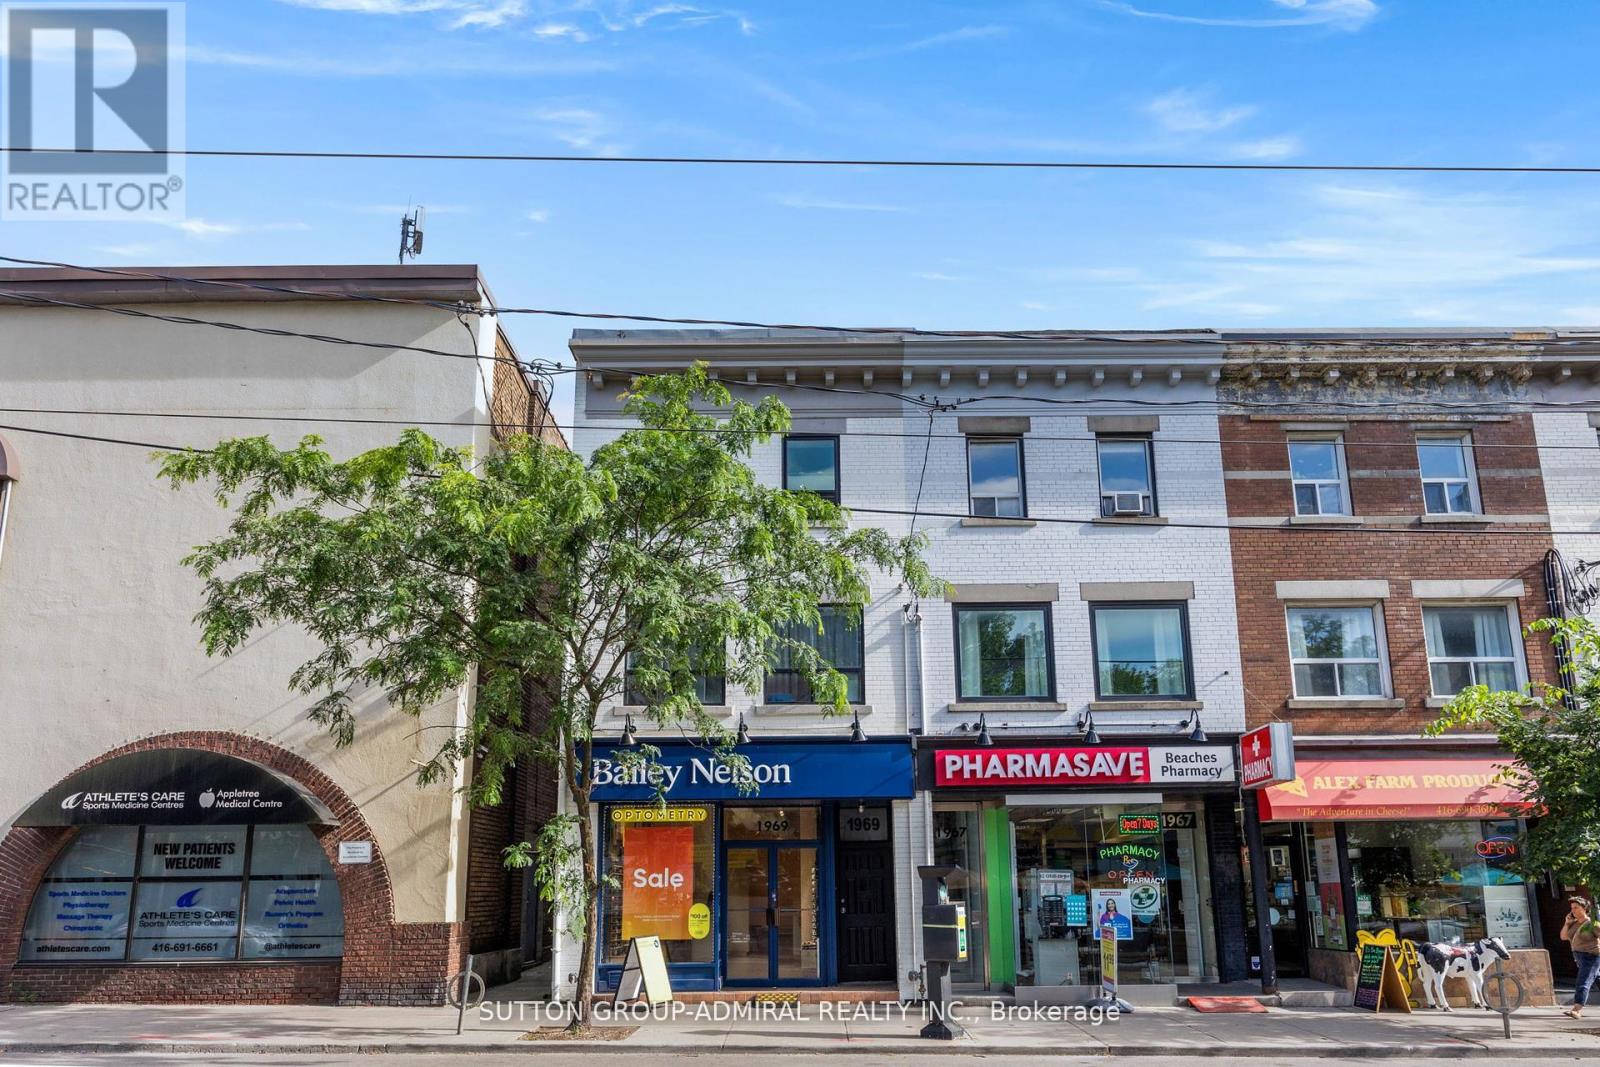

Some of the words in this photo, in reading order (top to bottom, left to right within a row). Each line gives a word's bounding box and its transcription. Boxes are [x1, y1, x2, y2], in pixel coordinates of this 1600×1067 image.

[1165, 752, 1218, 763] Beaches
[945, 752, 1144, 779] PHARMASAVE
[1244, 757, 1273, 782] PHARMACY
[591, 758, 683, 793] Bailey
[690, 757, 792, 784] Nelson
[1161, 765, 1223, 779] Pharmacy
[1313, 775, 1361, 789] ALEX
[1365, 775, 1418, 789] FARM
[83, 792, 149, 801] ATHLETE'S
[151, 792, 185, 801] CARE
[216, 789, 260, 799] Appletree
[82, 802, 110, 810] Sports
[151, 801, 185, 809] Centres
[215, 799, 251, 808] Medical
[253, 800, 283, 808] Centre
[612, 810, 706, 820] OPTOMETRY
[1318, 807, 1365, 817] Adventure
[1365, 807, 1374, 816] in
[849, 818, 880, 831] 1969
[1162, 814, 1193, 827] 1967
[757, 821, 789, 832] 1969
[936, 826, 967, 838] 1967
[153, 843, 181, 855] NEW
[182, 842, 236, 855] PATIENTS
[1099, 844, 1160, 860] PHARMACY
[1476, 841, 1516, 855] OPEN
[164, 857, 222, 870] WELCOME
[633, 867, 684, 888] Sale
[1123, 877, 1165, 885] PHARMACY
[86, 913, 112, 921] Therapy
[140, 911, 201, 919] ATHLETE'S
[204, 911, 236, 919] CARE
[138, 920, 165, 928] Sports
[166, 919, 201, 927] Medicine
[36, 945, 111, 953] athletescare.com
[152, 943, 219, 952] 416-691-6661
[264, 942, 321, 951] @athletescare
